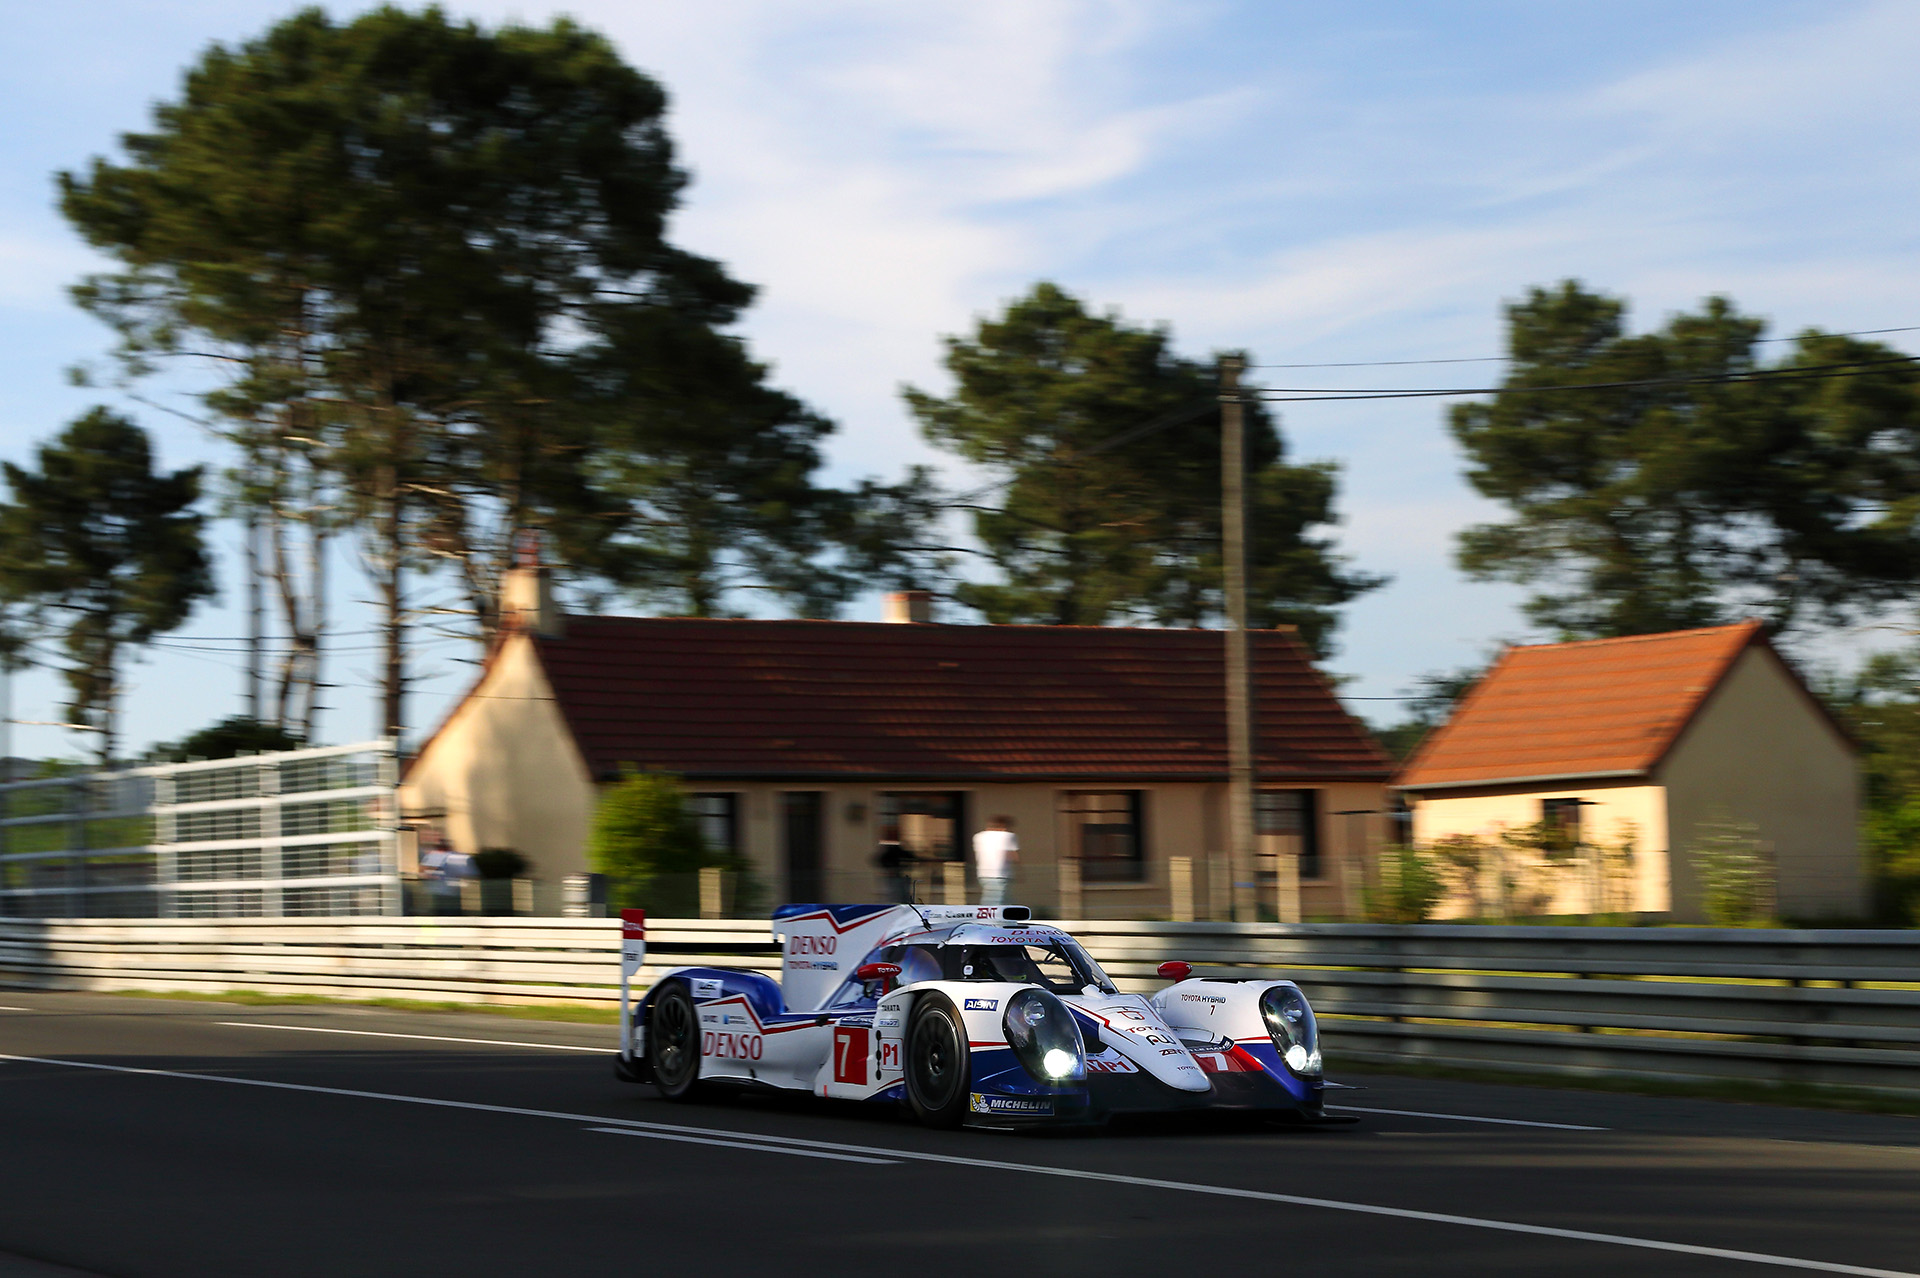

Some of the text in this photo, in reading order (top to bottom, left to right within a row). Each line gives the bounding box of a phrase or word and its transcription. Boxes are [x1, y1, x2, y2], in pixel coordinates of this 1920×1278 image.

[977, 907, 998, 919] ZENT
[790, 936, 837, 955] DENSO
[965, 1000, 996, 1010] AISIN
[1181, 994, 1226, 1004] TOYOTA HYBRID
[1210, 1005, 1215, 1015] 7
[702, 1031, 763, 1060] DENSO
[837, 1034, 851, 1077] 7
[883, 1043, 898, 1066] P1
[1103, 1060, 1132, 1072] P1
[1196, 1053, 1229, 1071] 7
[991, 1099, 1051, 1110] MICHELIN
